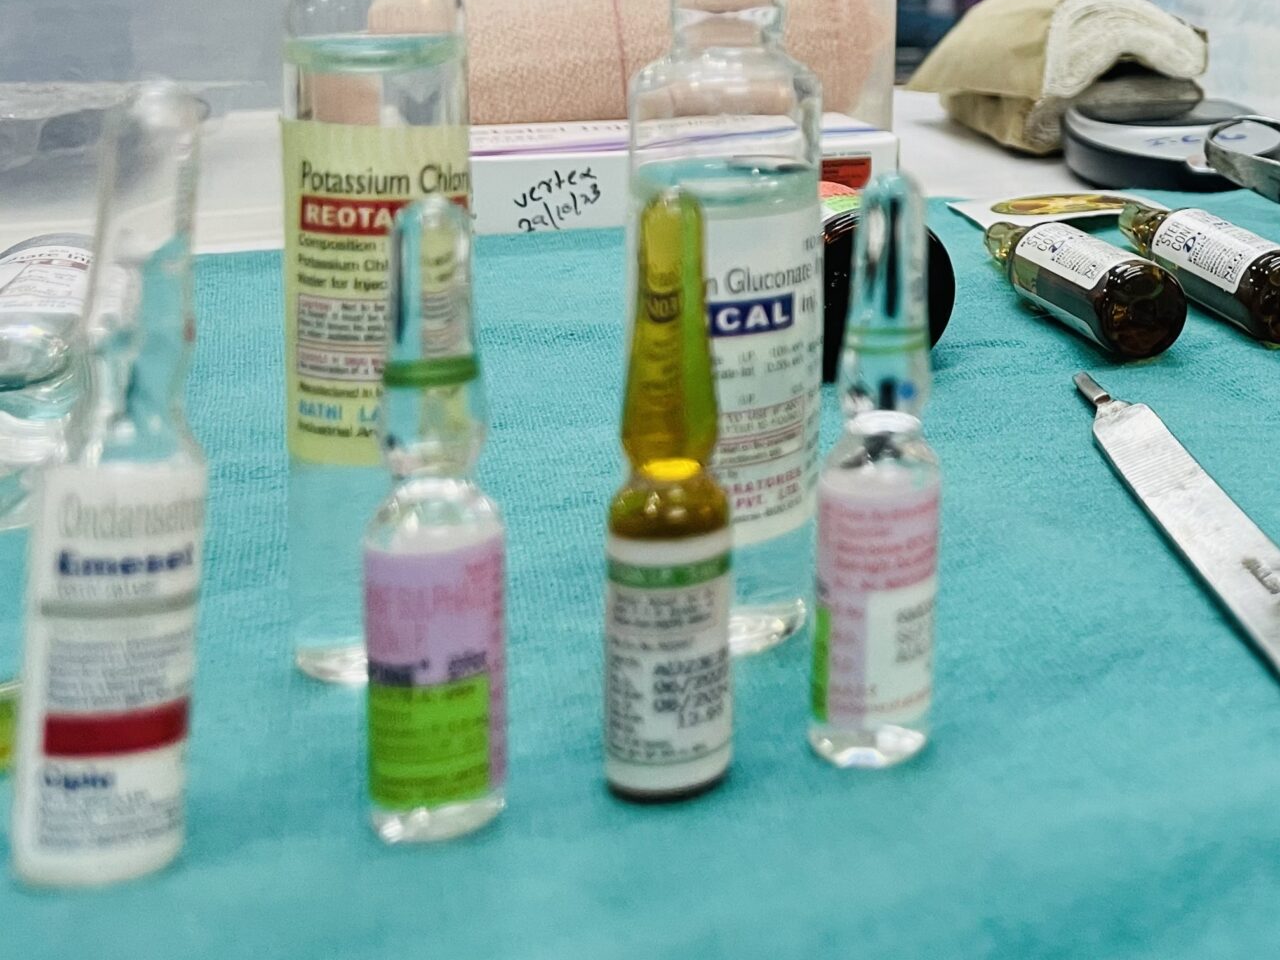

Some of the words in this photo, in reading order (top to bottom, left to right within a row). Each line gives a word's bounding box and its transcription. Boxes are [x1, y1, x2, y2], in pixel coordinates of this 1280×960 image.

[301, 160, 411, 195] Potassium
[304, 202, 403, 230] REOTA
[298, 254, 361, 272] Potassium
[725, 262, 812, 295] Gluconate
